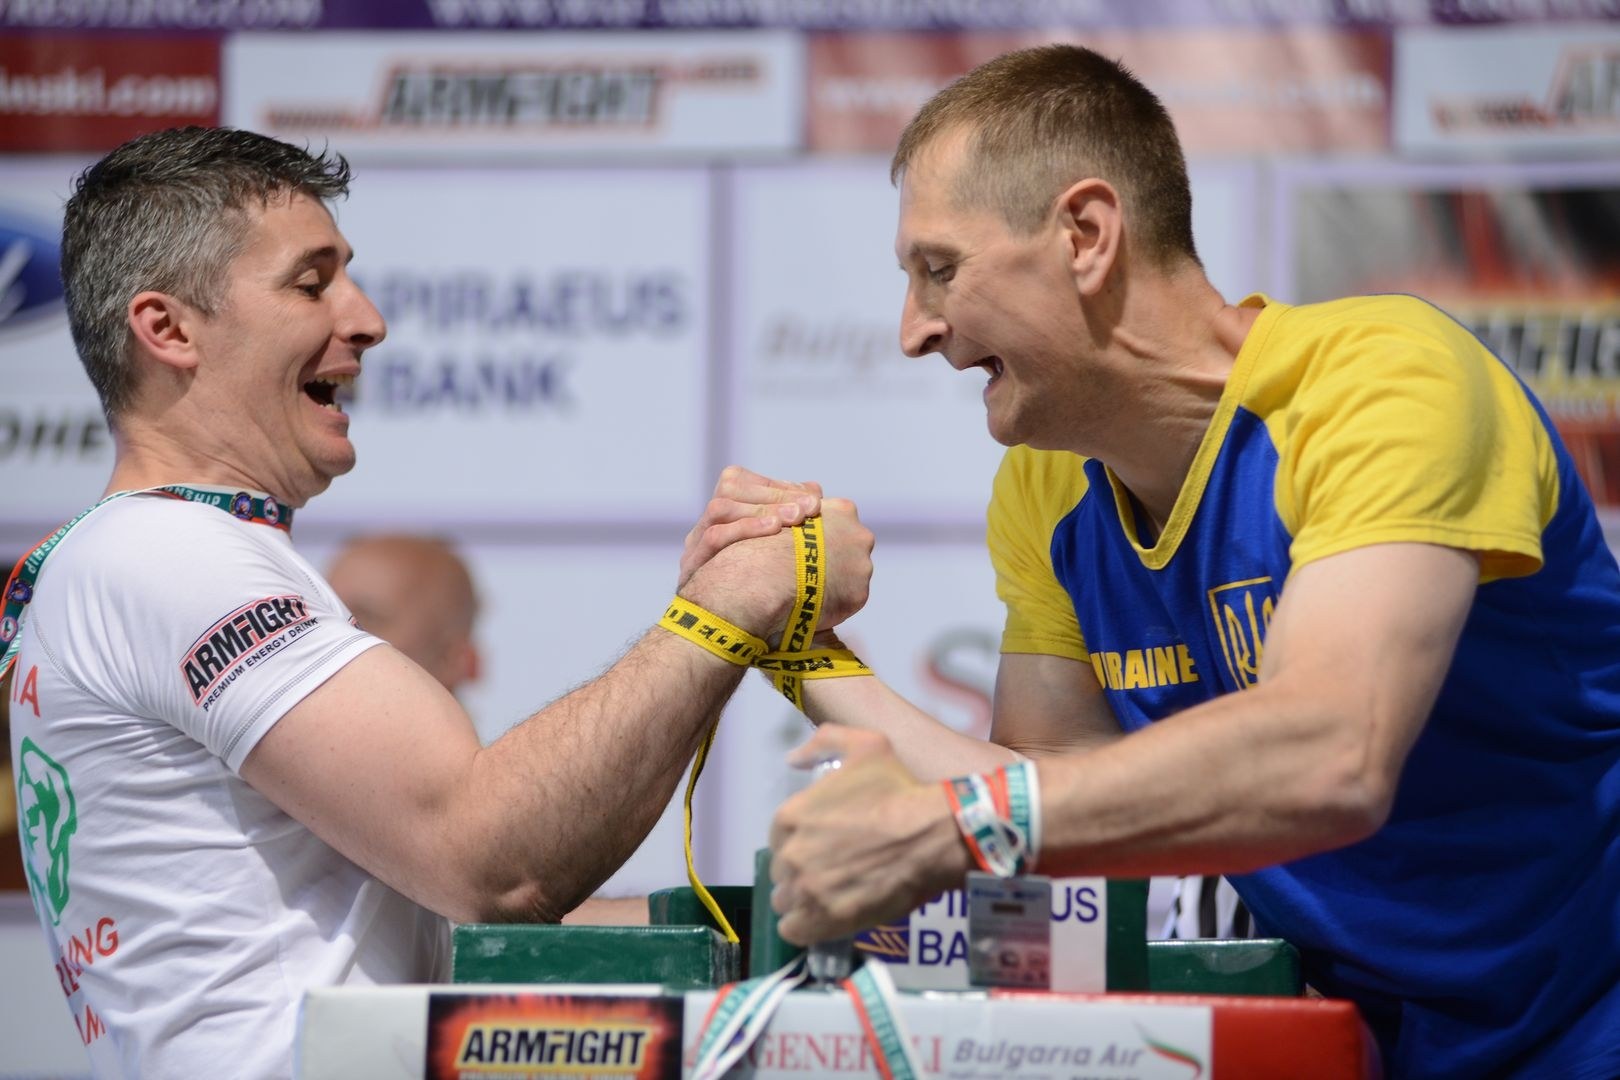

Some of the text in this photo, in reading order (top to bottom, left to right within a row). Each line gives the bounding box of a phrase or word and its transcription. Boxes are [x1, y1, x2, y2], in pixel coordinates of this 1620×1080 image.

[184, 597, 307, 700] ARMFIGHT
[203, 616, 319, 712] PREMIUM ENERGY DRINK
[462, 1028, 646, 1065] ARMFIGHT
[953, 1037, 1146, 1070] Bulgaria Air
